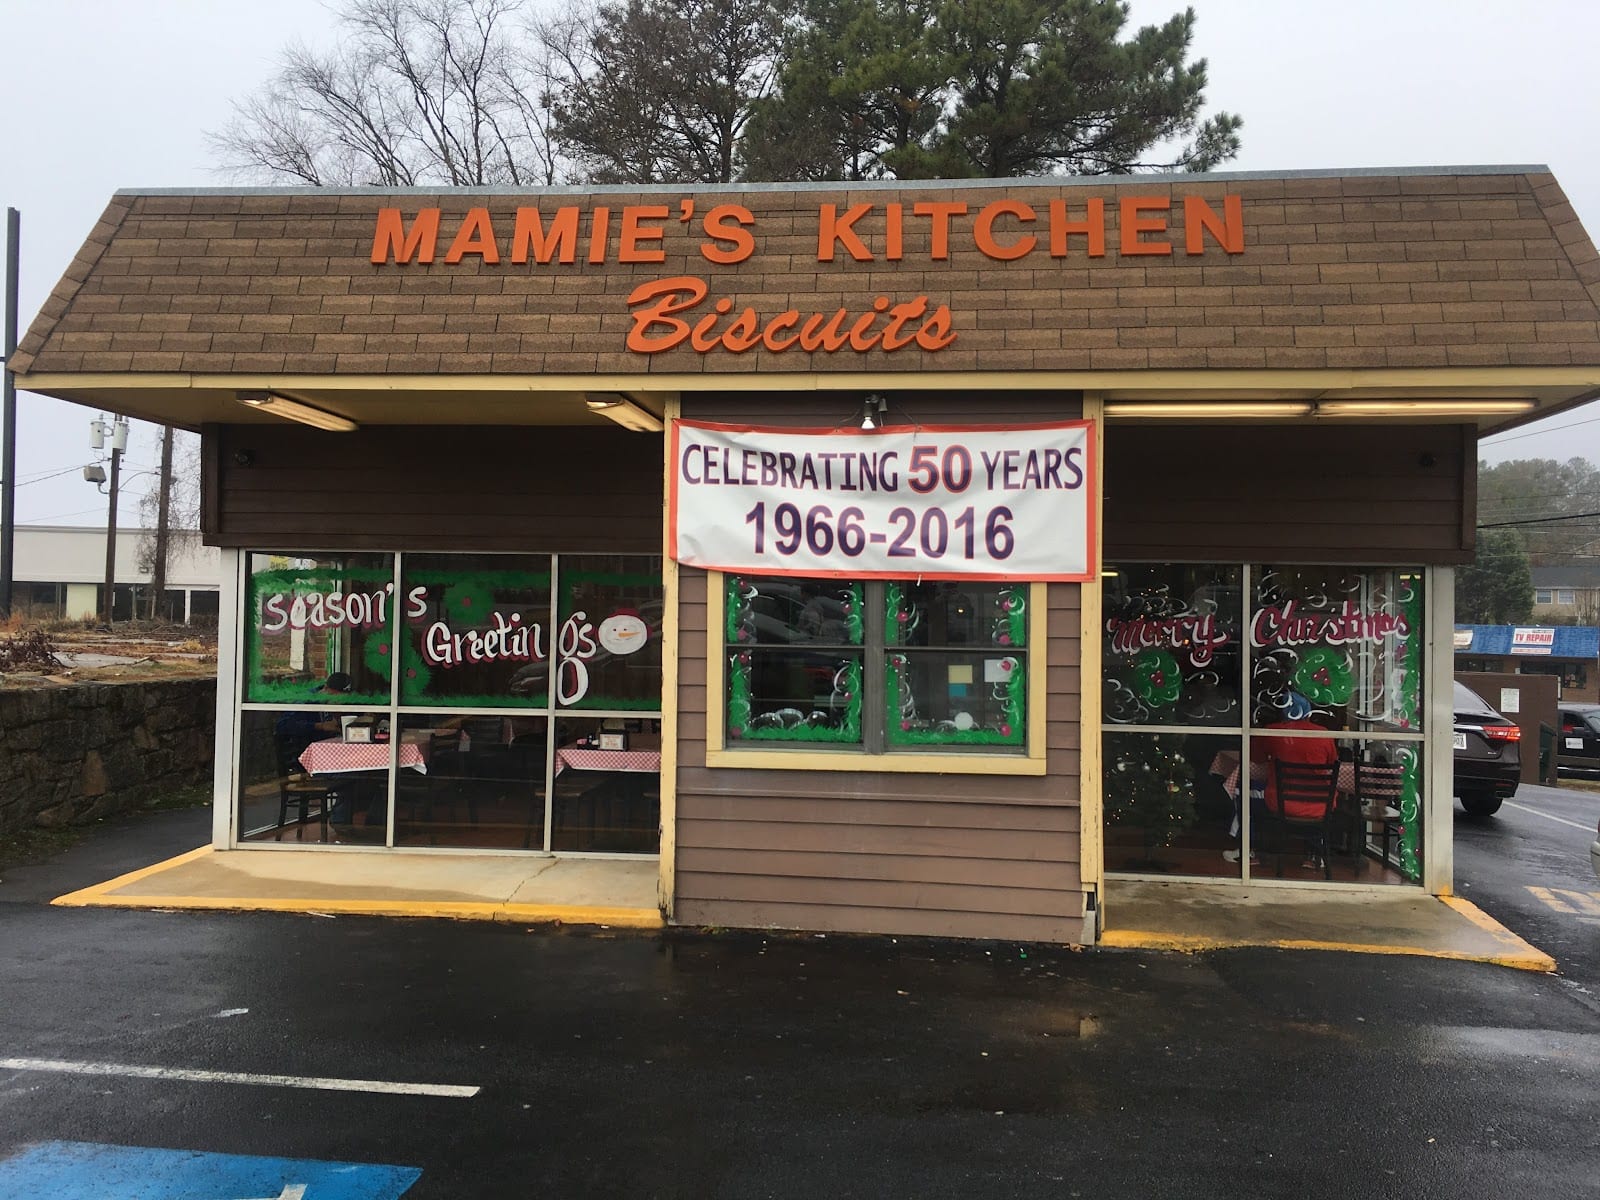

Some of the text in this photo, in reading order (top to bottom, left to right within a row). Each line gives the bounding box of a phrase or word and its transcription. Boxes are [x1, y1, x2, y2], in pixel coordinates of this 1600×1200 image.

[370, 195, 1245, 265] MAMIE'S KITCHEN
[626, 276, 958, 353] Biscuits
[681, 443, 1083, 494] CELEBRATING 50 YEARS
[744, 500, 1015, 561] 1966-2016
[423, 611, 597, 706] Greetings
[1106, 613, 1231, 668] Merry
[1515, 633, 1552, 642] TV REPAIR
